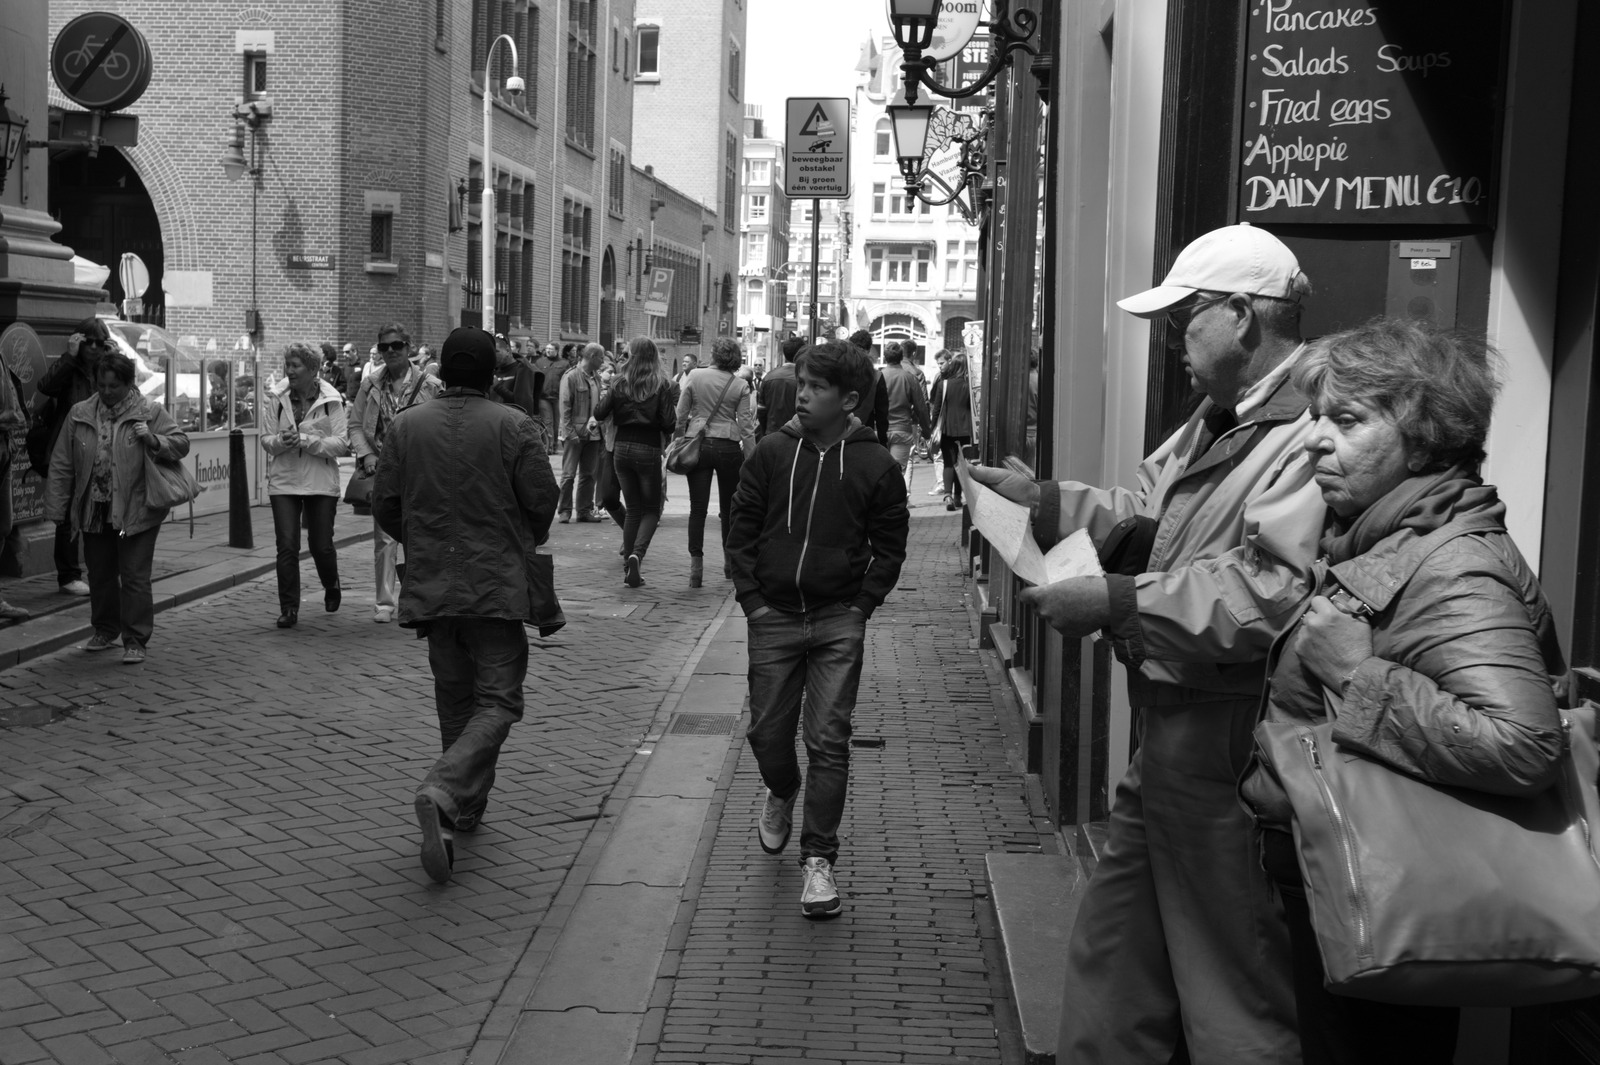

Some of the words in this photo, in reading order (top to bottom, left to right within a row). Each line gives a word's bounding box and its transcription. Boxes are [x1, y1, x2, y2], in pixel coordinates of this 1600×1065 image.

[1259, 0, 1378, 33] Pancakes
[1262, 44, 1349, 77] Salads
[1376, 44, 1451, 78] Soups
[1260, 89, 1320, 126] Fried
[1329, 98, 1391, 126] eggs
[792, 156, 843, 164] beweegbaar
[1244, 134, 1349, 174] Applepie
[798, 176, 809, 184] Bij
[809, 184, 842, 192] voertuig
[1246, 173, 1330, 211] DAILY
[1335, 174, 1422, 210] MENU
[653, 270, 668, 288] P
[719, 322, 728, 332] P
